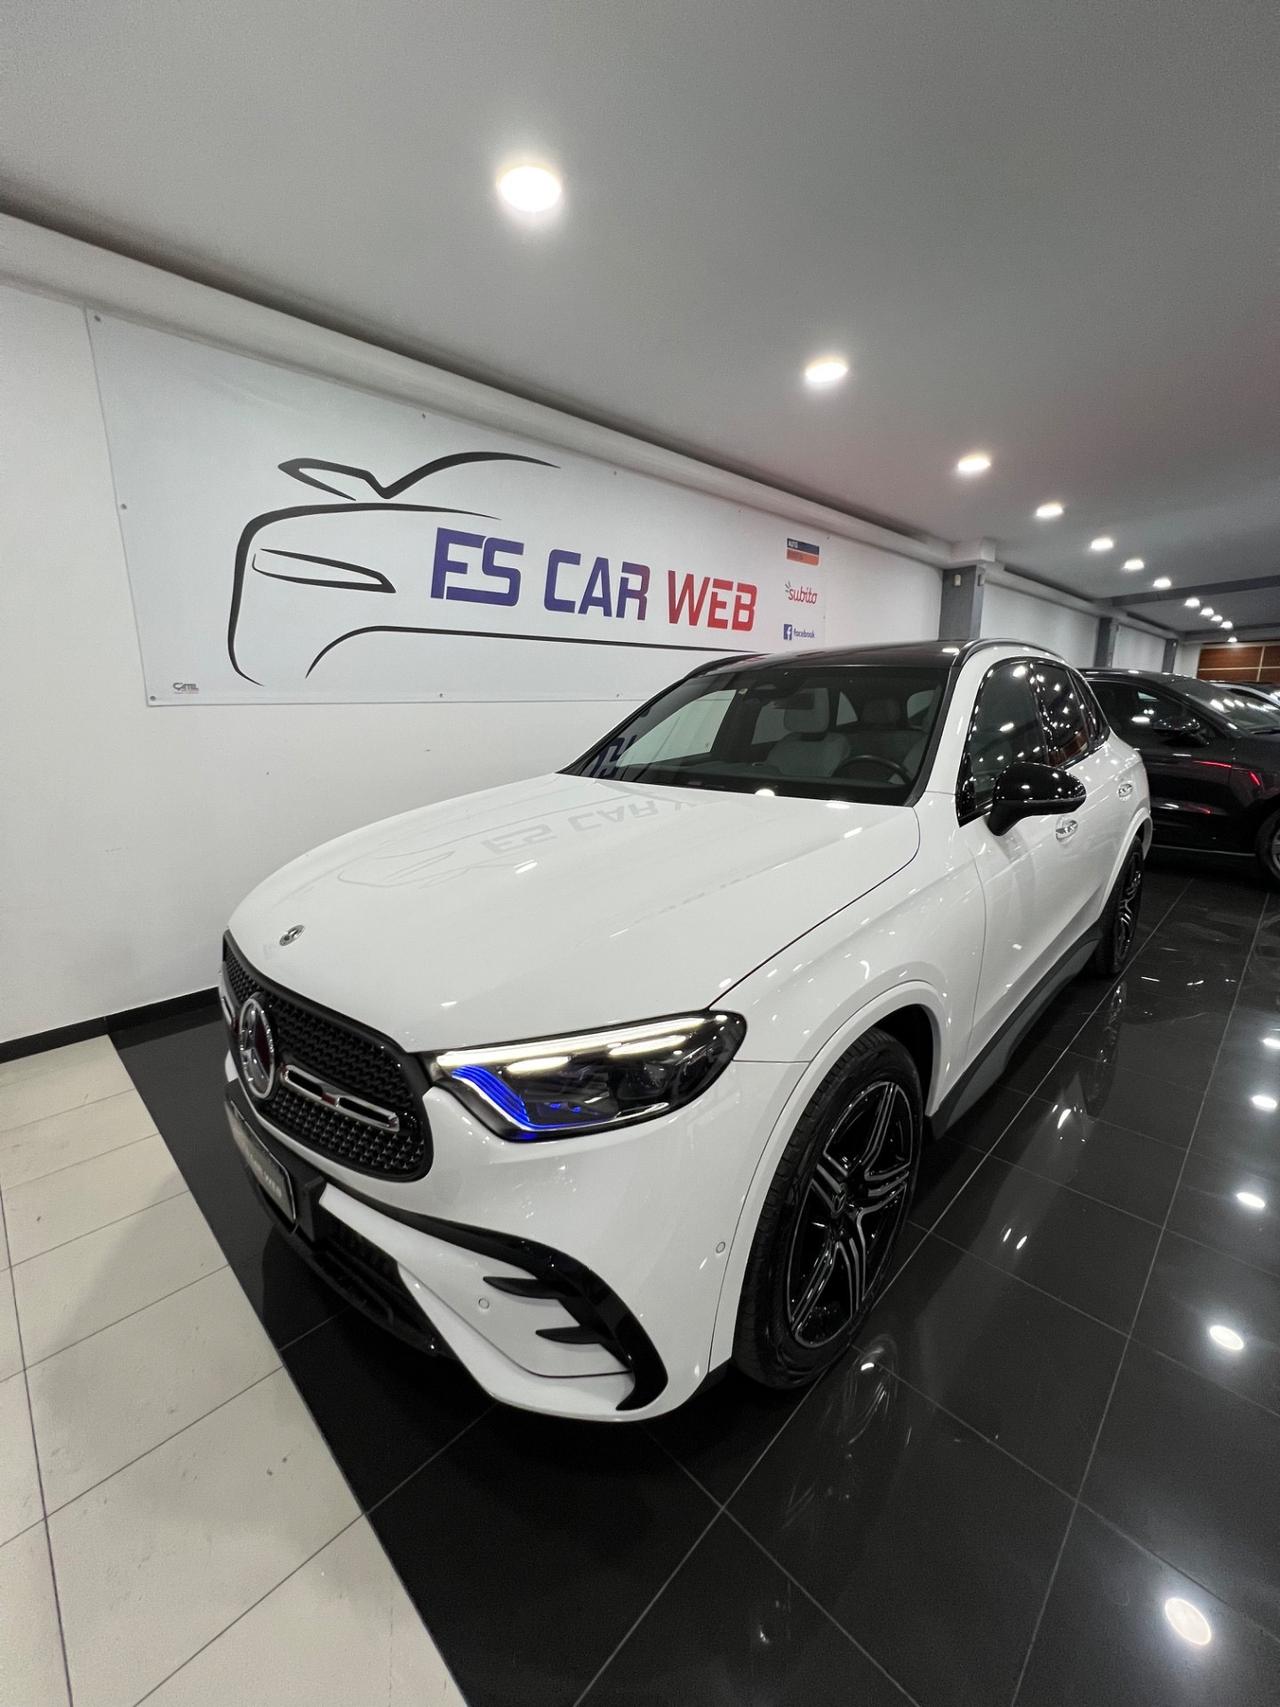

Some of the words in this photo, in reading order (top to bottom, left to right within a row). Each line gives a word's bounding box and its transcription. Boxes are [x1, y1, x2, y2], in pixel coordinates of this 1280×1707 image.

[430, 527, 525, 607] ES
[543, 548, 651, 621] CAR
[667, 569, 759, 632] WEB
[788, 585, 818, 605] subito
[793, 627, 816, 639] facebook
